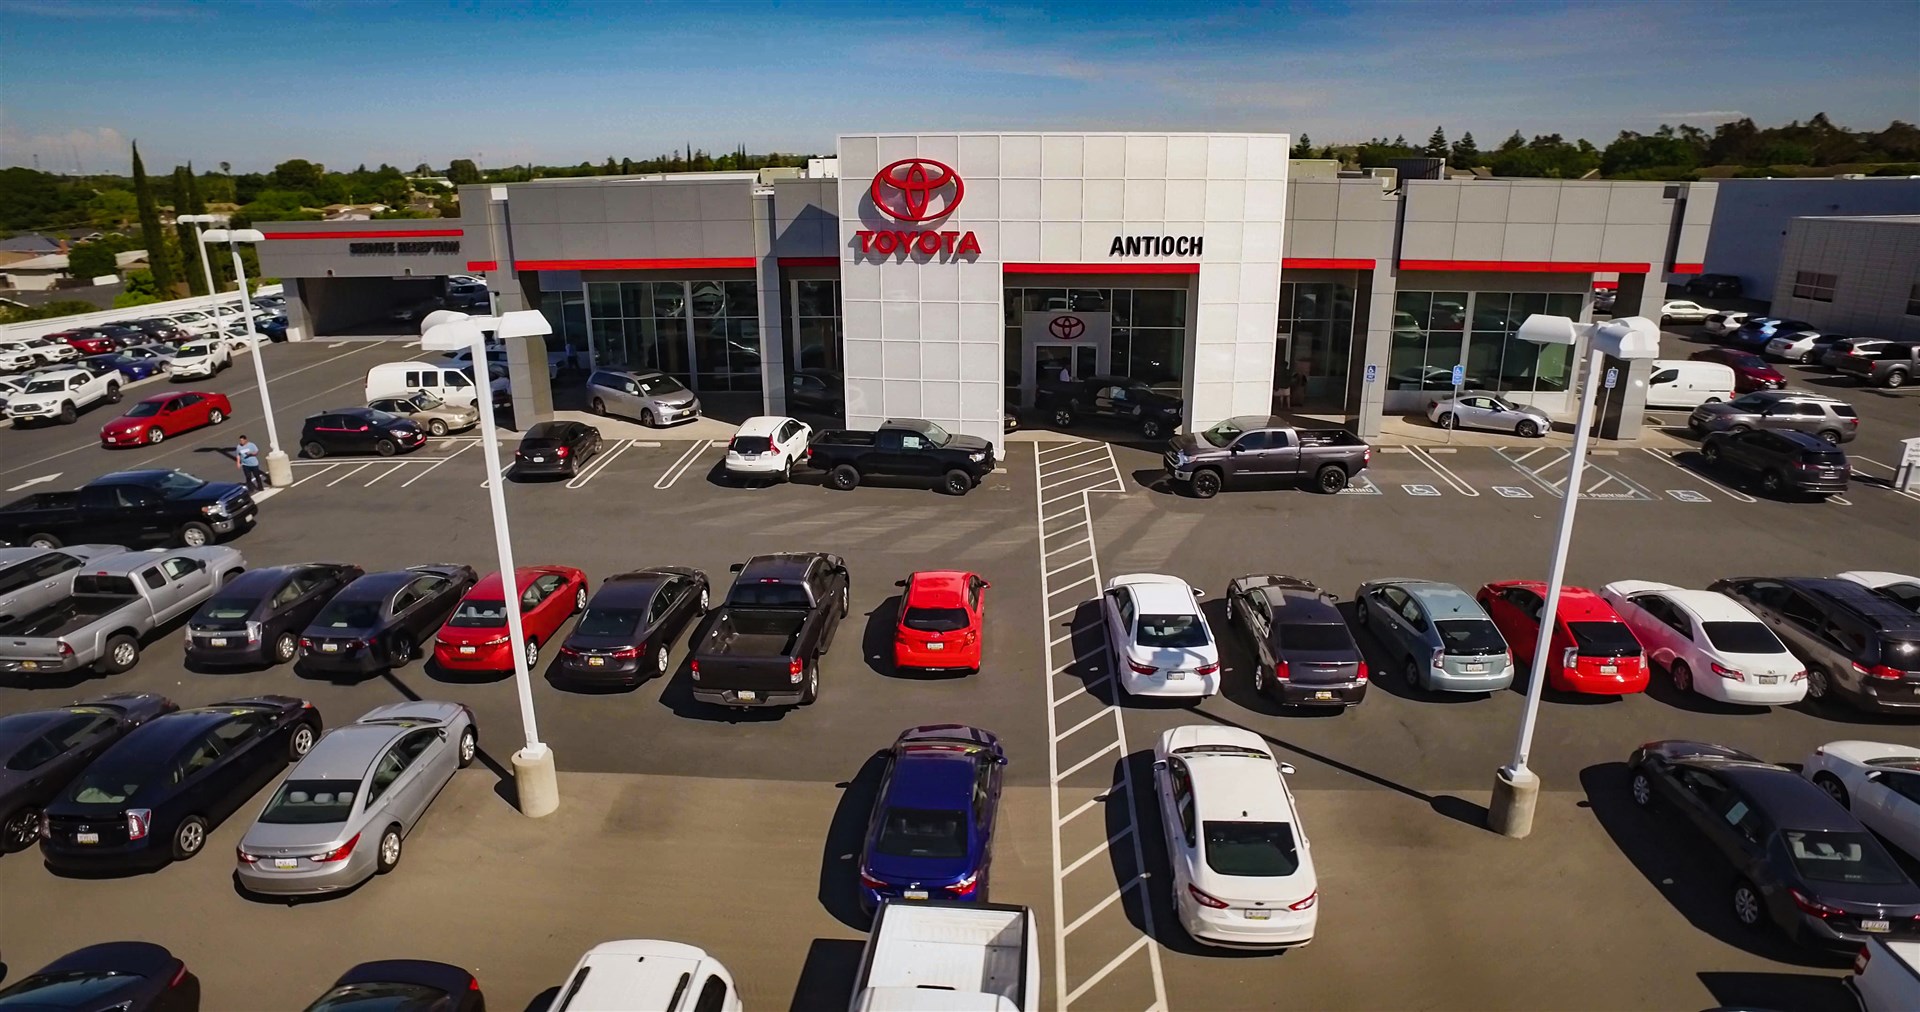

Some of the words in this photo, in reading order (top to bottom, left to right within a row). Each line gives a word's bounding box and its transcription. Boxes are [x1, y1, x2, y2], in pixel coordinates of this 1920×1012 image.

[349, 242, 396, 254] SERVICE
[397, 241, 460, 254] RECEPTION
[855, 230, 982, 255] TOYOTA
[1109, 235, 1204, 257] ANTIOCH
